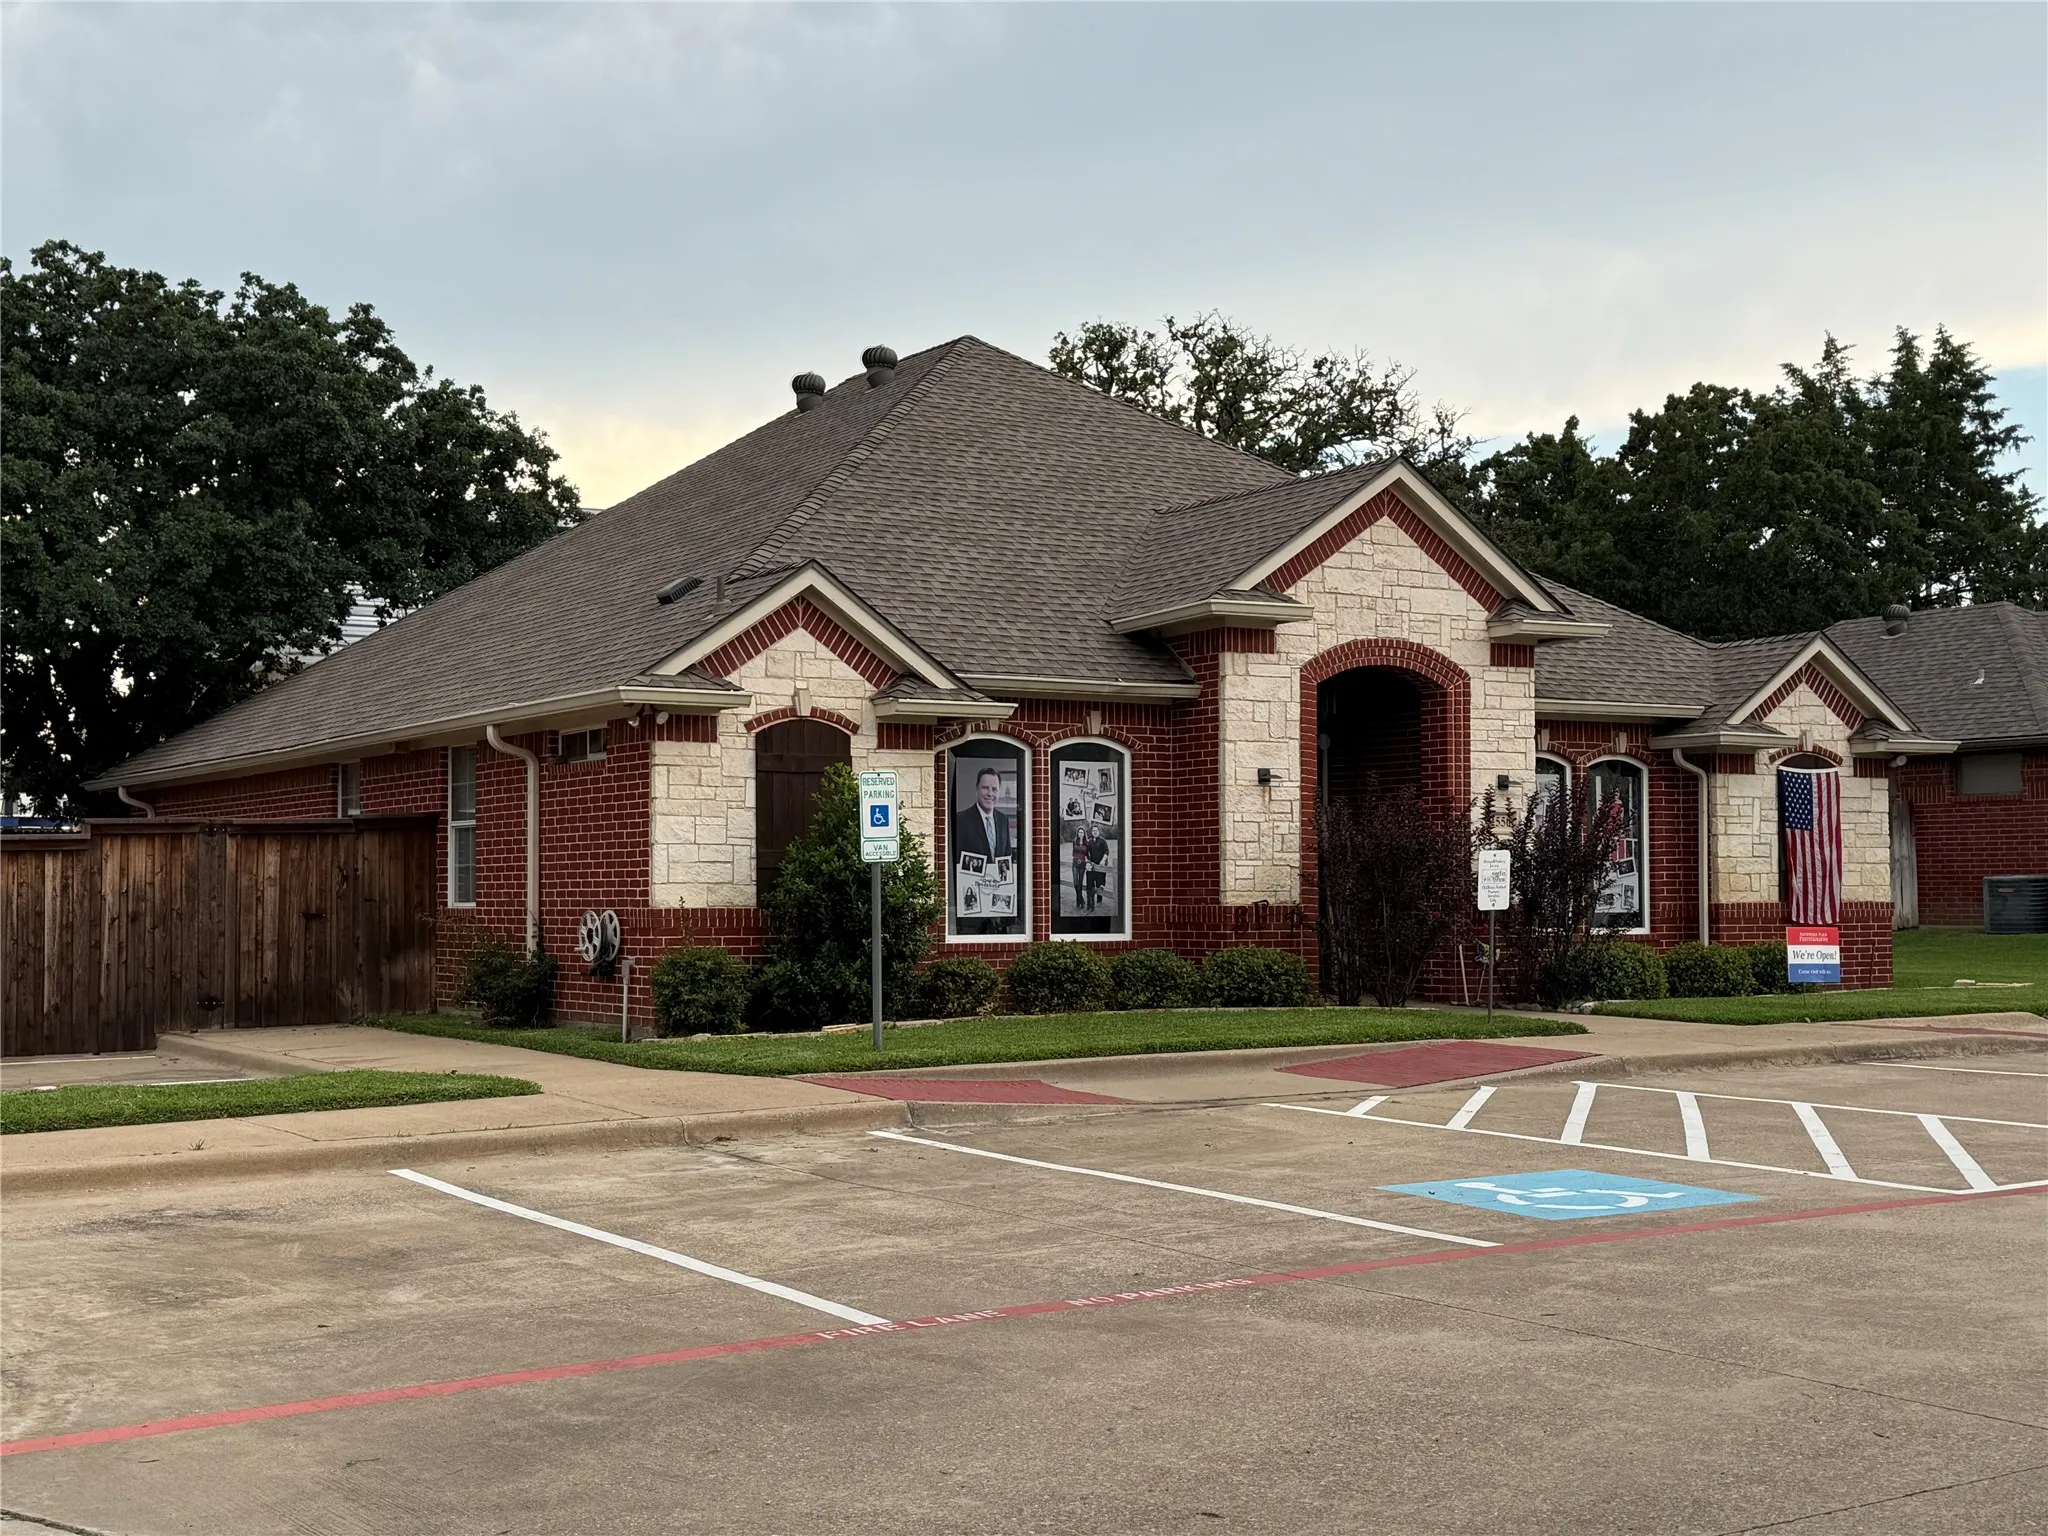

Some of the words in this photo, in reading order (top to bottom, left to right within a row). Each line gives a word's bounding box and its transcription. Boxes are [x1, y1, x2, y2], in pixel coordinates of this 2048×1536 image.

[863, 777, 895, 786] RESERVED
[863, 790, 895, 799] PARKING
[873, 844, 889, 852] VAN
[1792, 949, 1815, 960] We're
[1815, 949, 1837, 962] Open!
[816, 1322, 905, 1340] FIRE
[907, 1309, 1007, 1327] LANE
[1065, 1296, 1115, 1307] NO
[1116, 1278, 1256, 1300] PARKING
